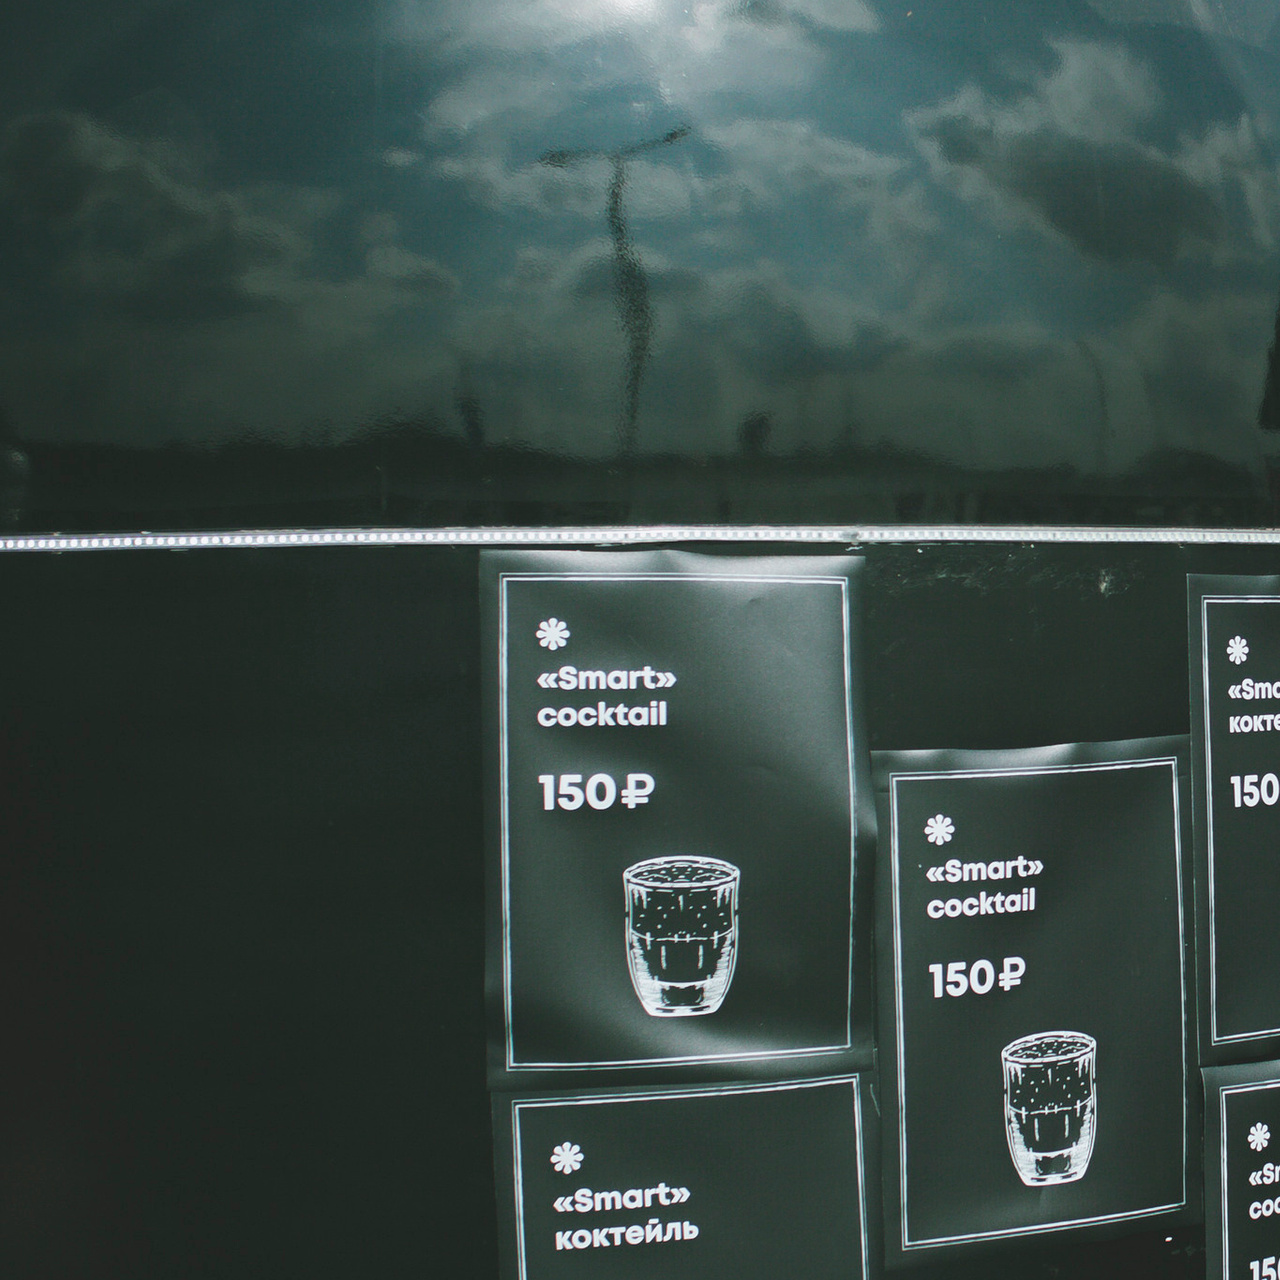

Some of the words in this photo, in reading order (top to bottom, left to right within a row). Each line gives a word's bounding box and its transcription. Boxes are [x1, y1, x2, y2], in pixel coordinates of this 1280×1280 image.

[537, 666, 676, 690] «Smart»
[538, 701, 666, 726] cocktail
[539, 773, 654, 810] 150₽
[926, 856, 1043, 882] «Smart»
[927, 888, 1035, 918] cocktail
[929, 957, 1025, 998] 150₽
[553, 1183, 690, 1212] «Smart»
[556, 1218, 699, 1250] коктейль
